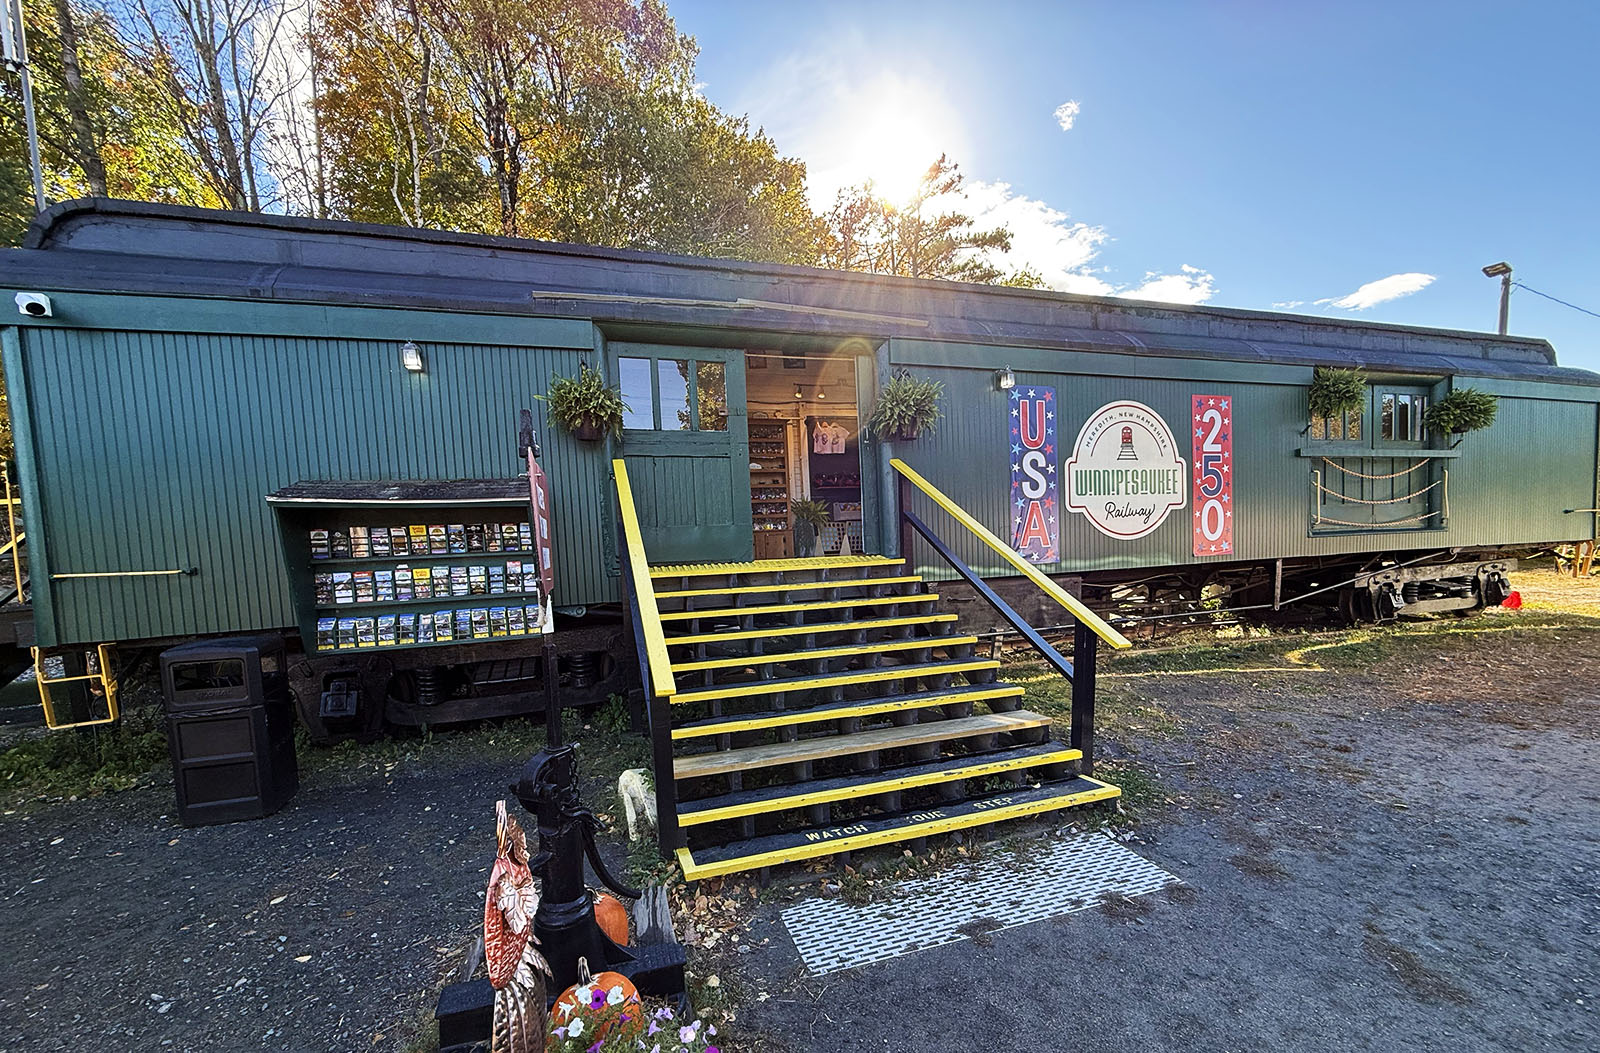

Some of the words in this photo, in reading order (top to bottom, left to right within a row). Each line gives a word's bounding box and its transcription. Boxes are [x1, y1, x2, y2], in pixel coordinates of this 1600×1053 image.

[1086, 415, 1117, 448] MEREDITH,
[1136, 414, 1167, 448] HAMPSHIRE
[1019, 400, 1052, 549] USA
[1075, 469, 1178, 496] WINNIPESAUKEE
[1200, 408, 1225, 542] 250
[1104, 501, 1156, 525] Railway
[805, 824, 868, 842] WATCH
[973, 796, 1013, 809] STEP
